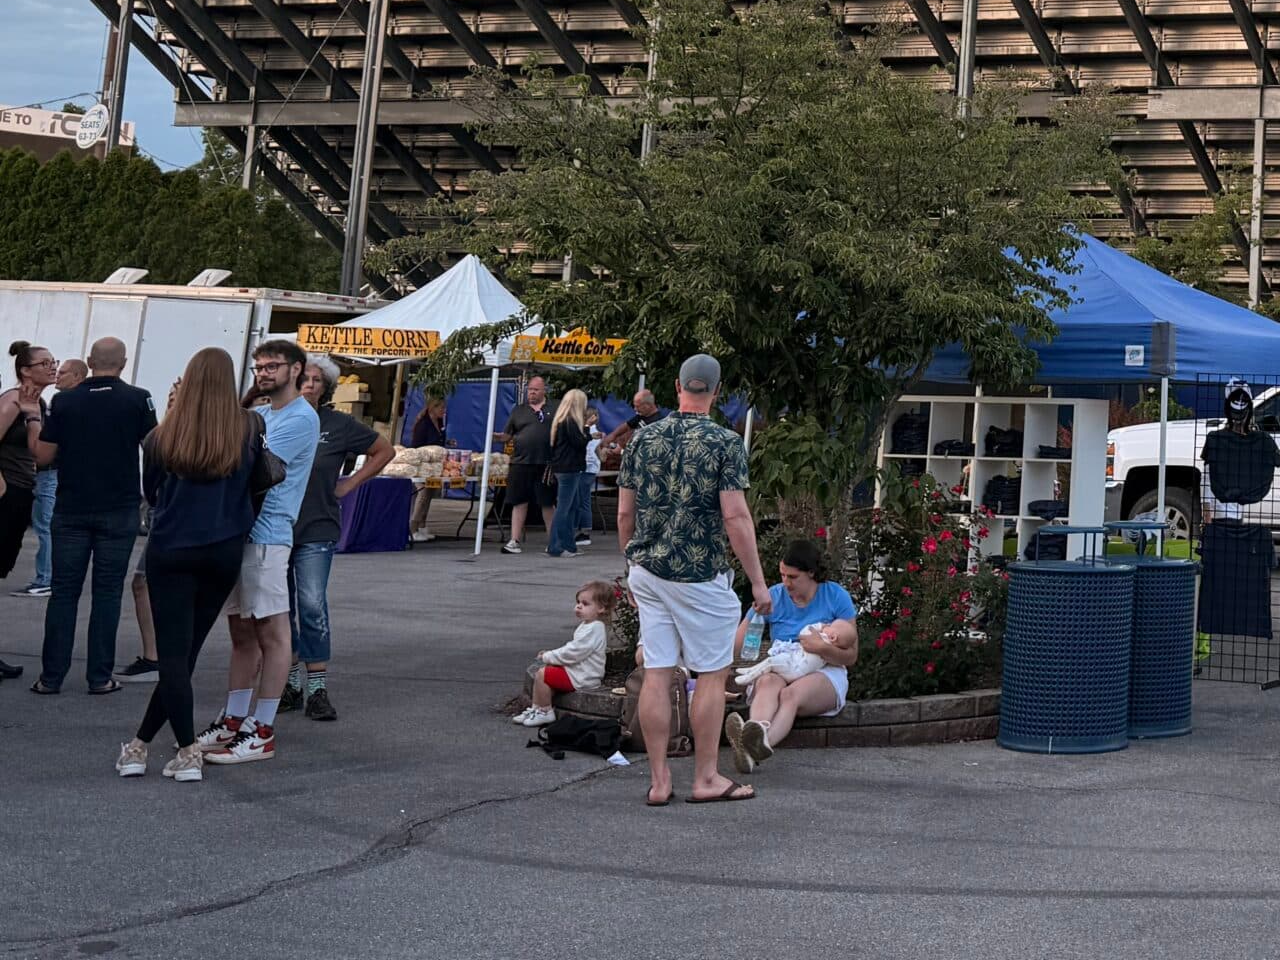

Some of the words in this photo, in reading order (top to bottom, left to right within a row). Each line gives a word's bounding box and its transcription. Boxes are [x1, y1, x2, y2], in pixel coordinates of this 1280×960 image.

[14, 113, 32, 126] TO
[80, 120, 100, 129] SEATS
[306, 325, 373, 346] KETTLE
[382, 328, 430, 349] CORN
[339, 346, 349, 354] BY
[354, 347, 368, 355] THE
[371, 348, 411, 356] POPCORN
[542, 338, 582, 355] Kettle
[583, 340, 615, 355] Corn
